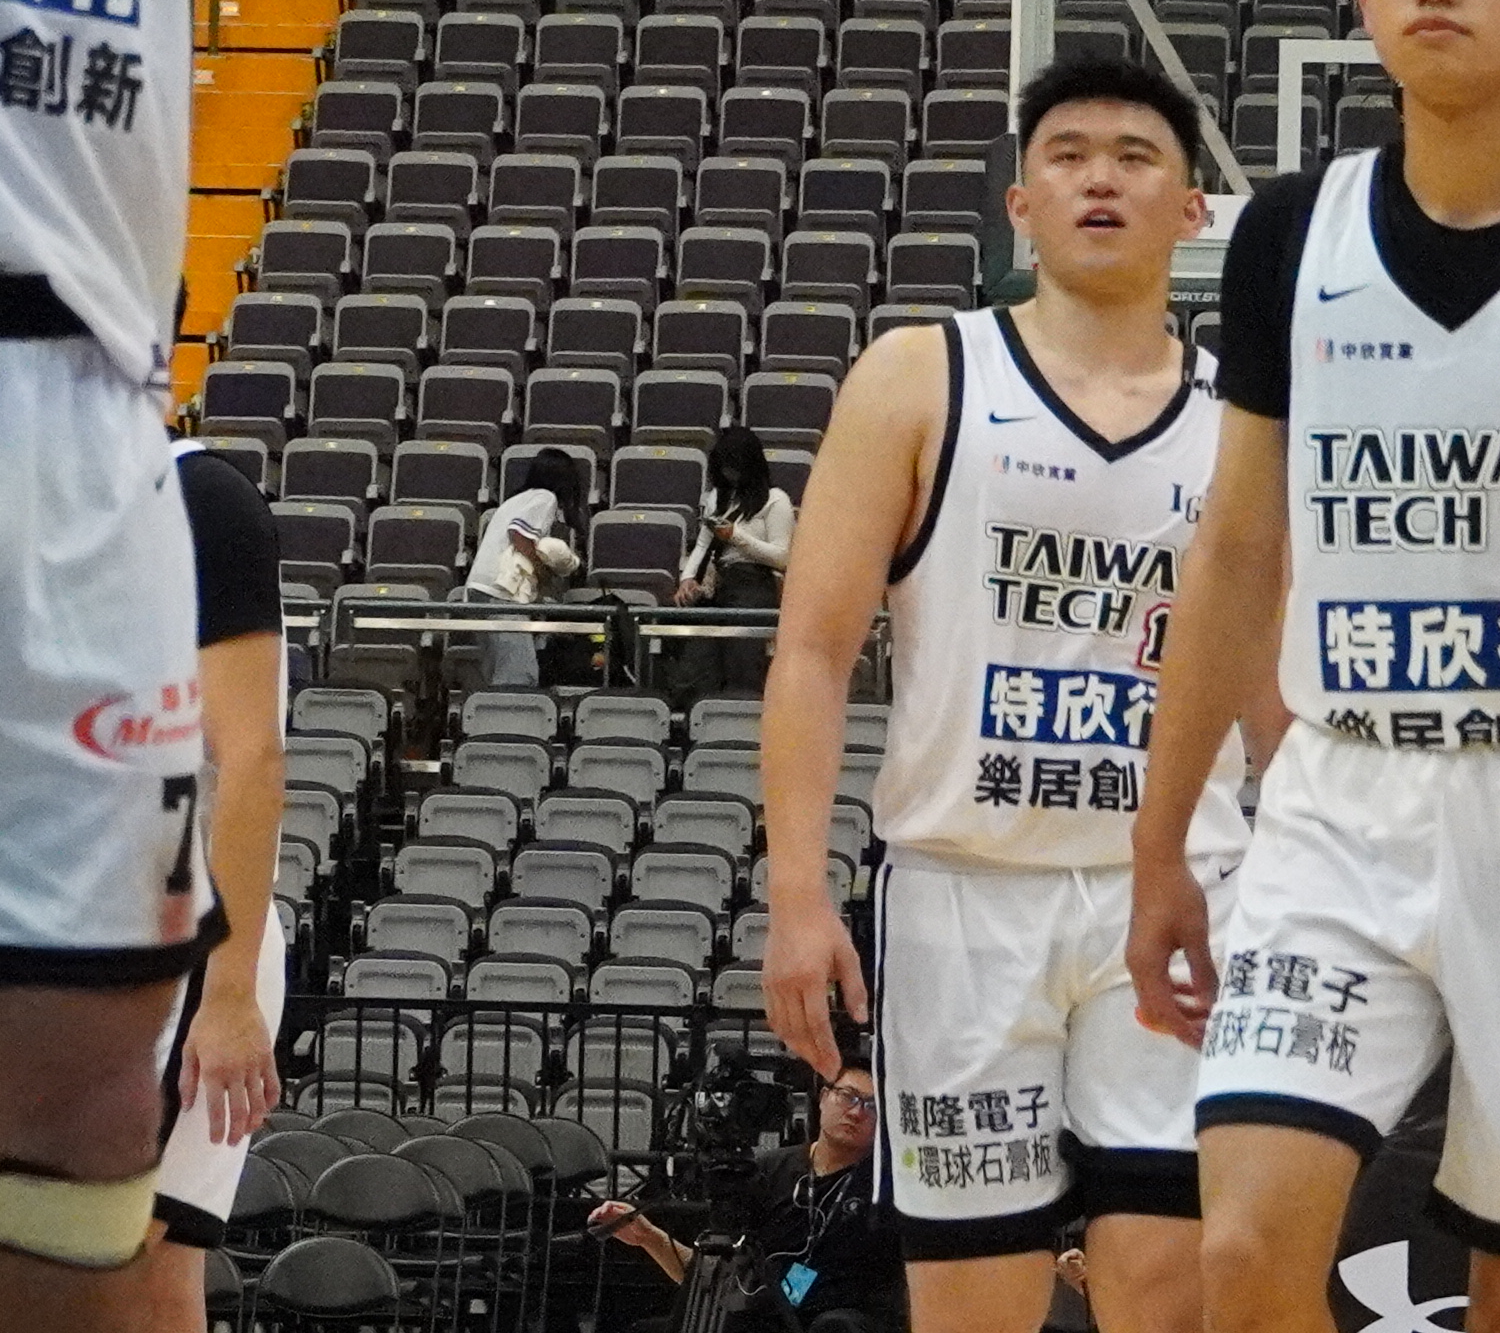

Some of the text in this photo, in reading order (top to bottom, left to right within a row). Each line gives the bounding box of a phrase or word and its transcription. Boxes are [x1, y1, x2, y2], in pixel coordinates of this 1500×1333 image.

[1169, 483, 1203, 524] IG
[1309, 495, 1484, 546] TECH
[990, 526, 1175, 594] TAIWA
[987, 576, 1134, 633] TECH
[974, 753, 1146, 813] 樂居創
[162, 773, 197, 895] 7
[1223, 950, 1368, 1014] 隆電子
[898, 1085, 1049, 1139] 義隆電子
